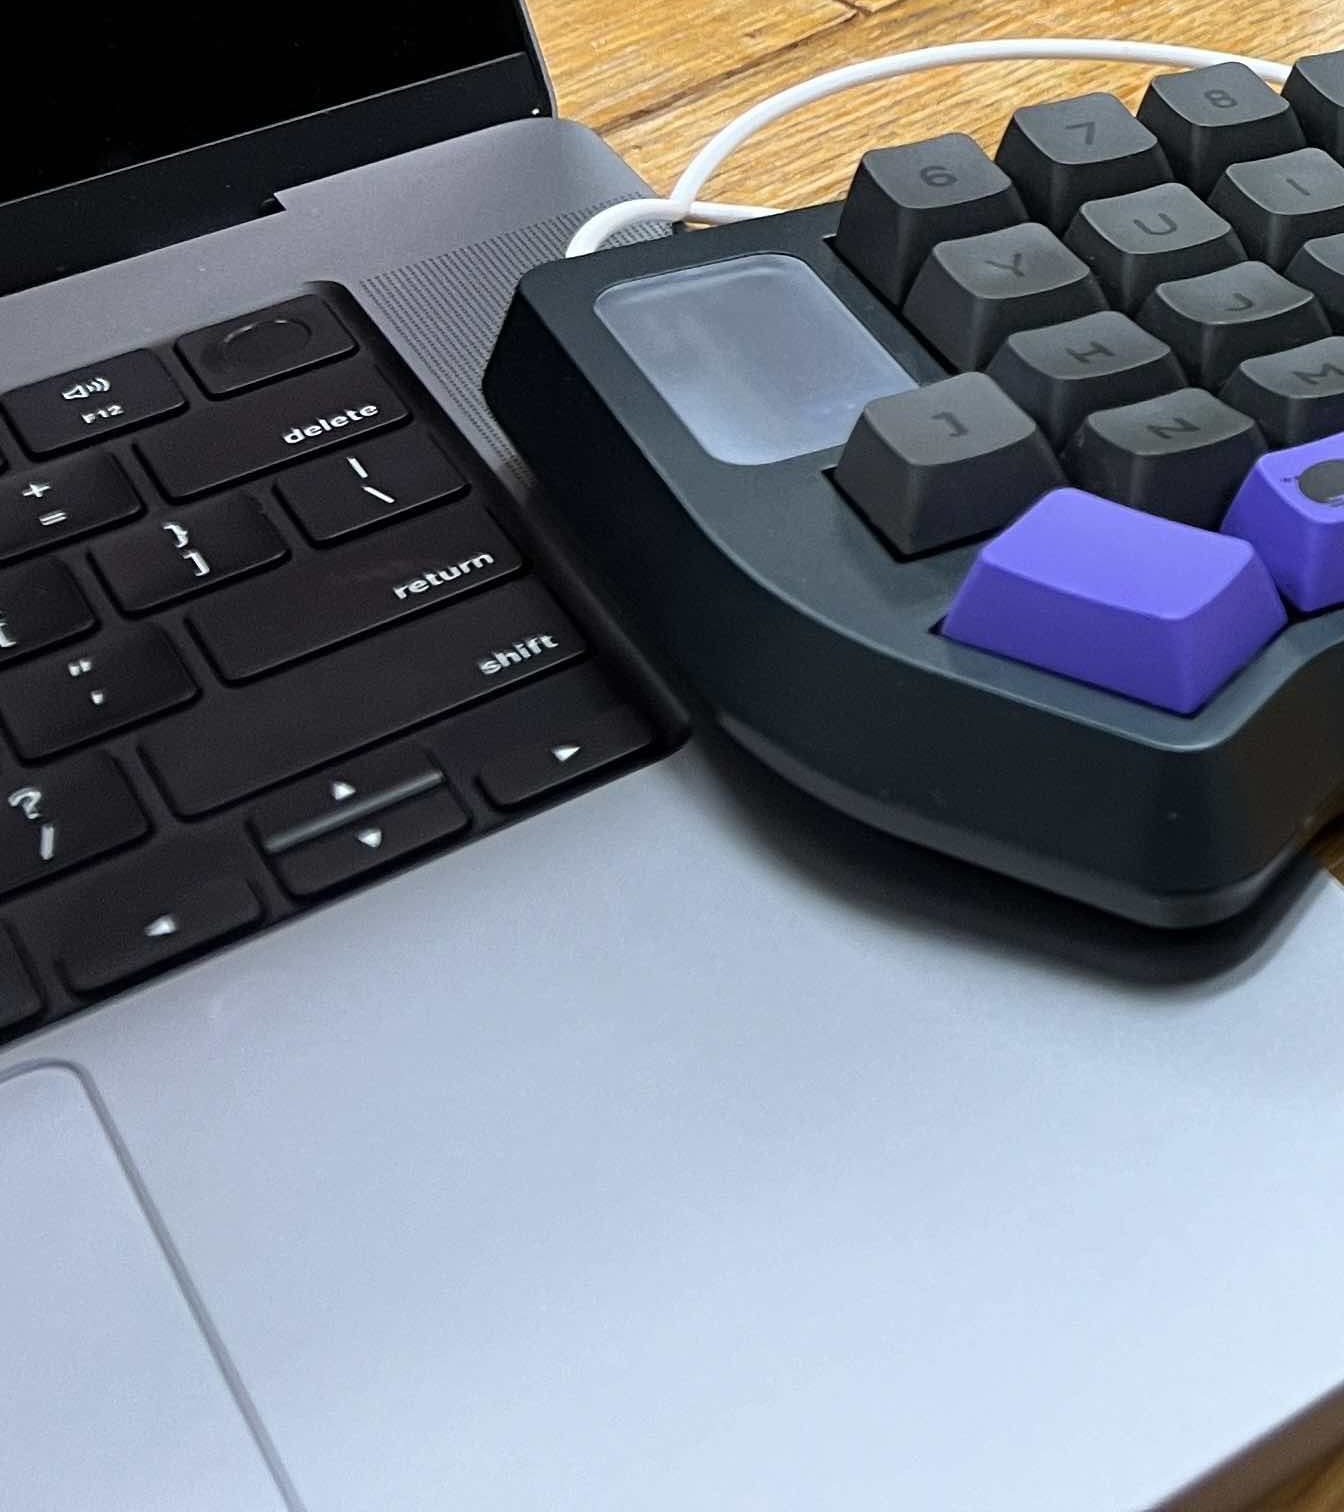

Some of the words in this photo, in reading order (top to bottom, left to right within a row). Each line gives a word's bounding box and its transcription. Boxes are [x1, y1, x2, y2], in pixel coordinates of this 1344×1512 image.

[1203, 88, 1238, 110] 8
[1064, 120, 1096, 145] 7
[919, 164, 958, 189] 6
[1133, 212, 1178, 236] U
[985, 252, 1026, 278] Y
[1225, 292, 1256, 312] J
[1067, 341, 1116, 365] H
[80, 403, 125, 425] F12
[282, 400, 380, 446] delete
[1146, 415, 1201, 440] N
[392, 550, 496, 601] return
[477, 631, 560, 676] shift
[9, 786, 43, 820] ?
